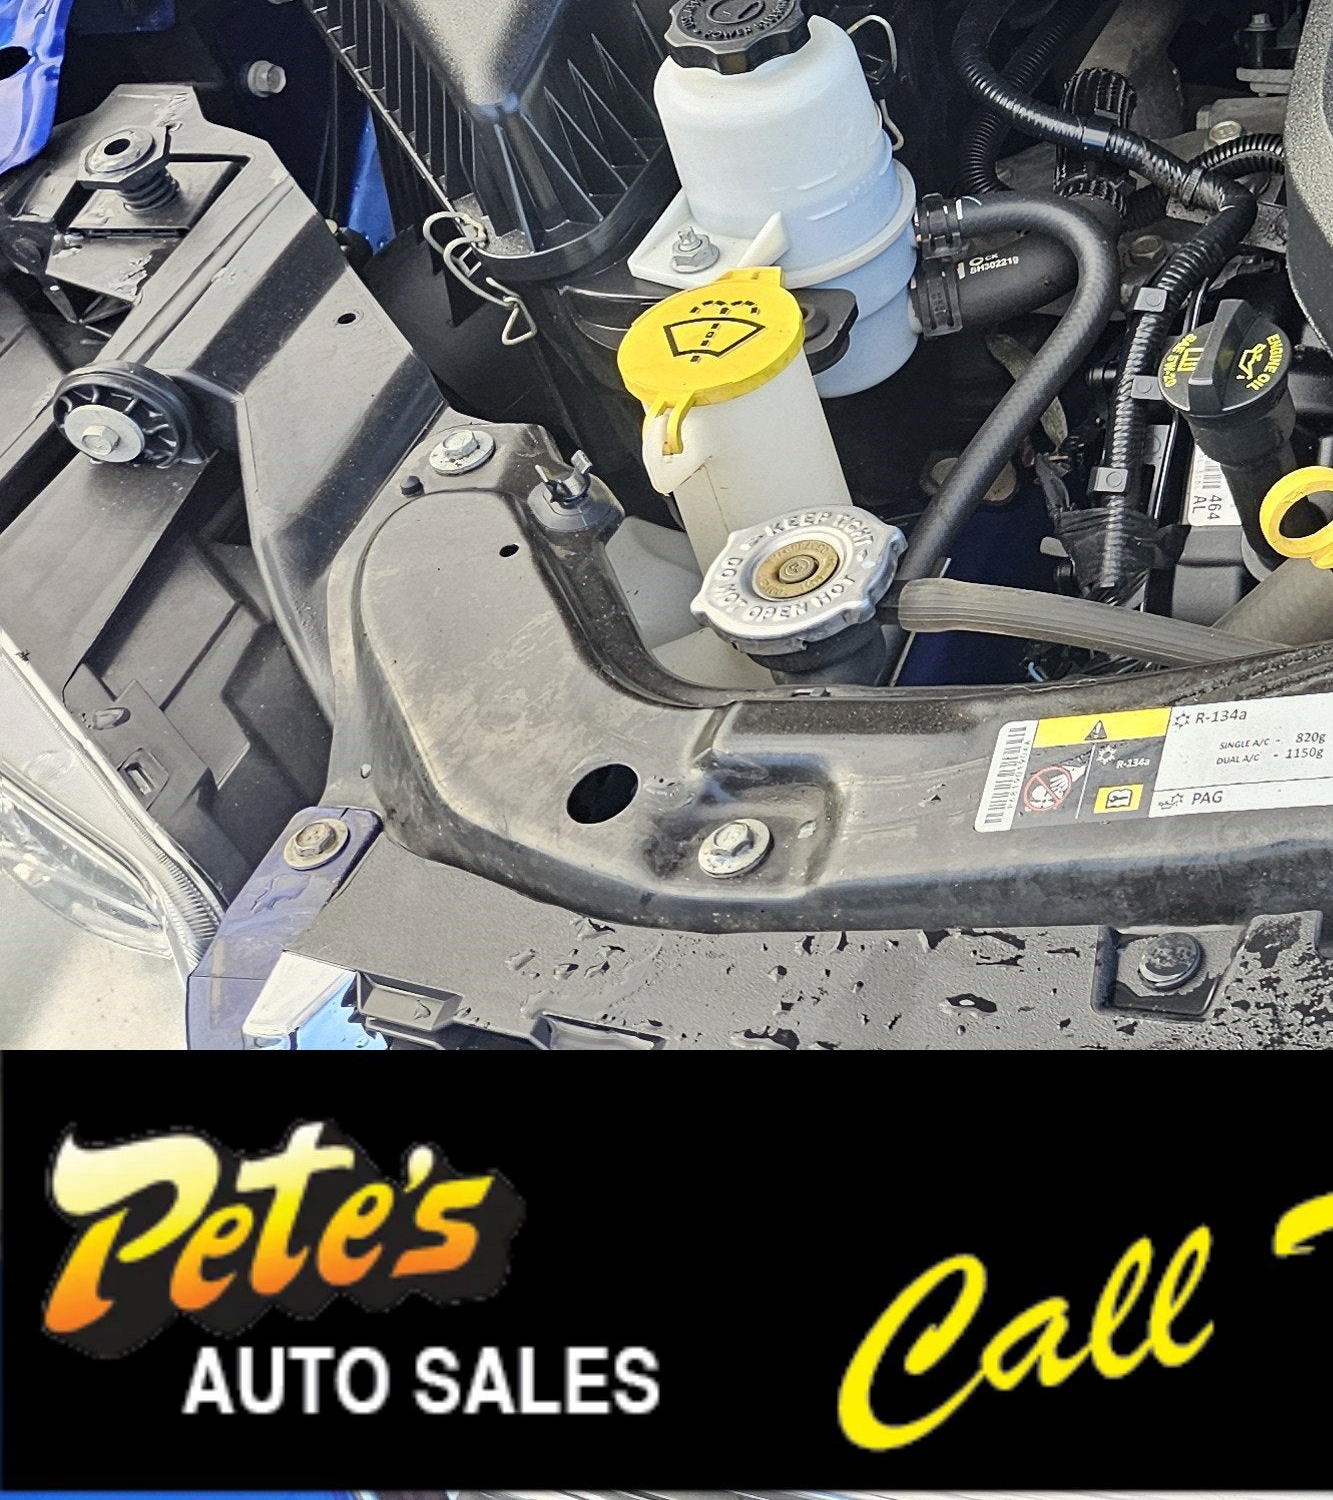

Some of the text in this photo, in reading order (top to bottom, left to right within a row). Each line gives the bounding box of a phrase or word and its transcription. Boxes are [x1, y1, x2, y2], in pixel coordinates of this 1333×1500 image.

[1162, 354, 1179, 388] 5W-20
[1246, 334, 1283, 391] ENGINE OIL
[764, 511, 833, 536] KEEP
[832, 513, 875, 546] TIGHT
[811, 575, 855, 608] HOT
[741, 604, 808, 621] OPEN
[1195, 708, 1247, 724] R-134a
[1219, 740, 1251, 750] SINGLE
[1252, 738, 1270, 748] A/C
[1296, 731, 1327, 744] 820g
[1116, 758, 1150, 769] R-134a
[1216, 755, 1241, 765] DUAL
[1243, 753, 1260, 764] A/C
[1285, 748, 1324, 760] 1150g
[1192, 790, 1223, 805] PAG
